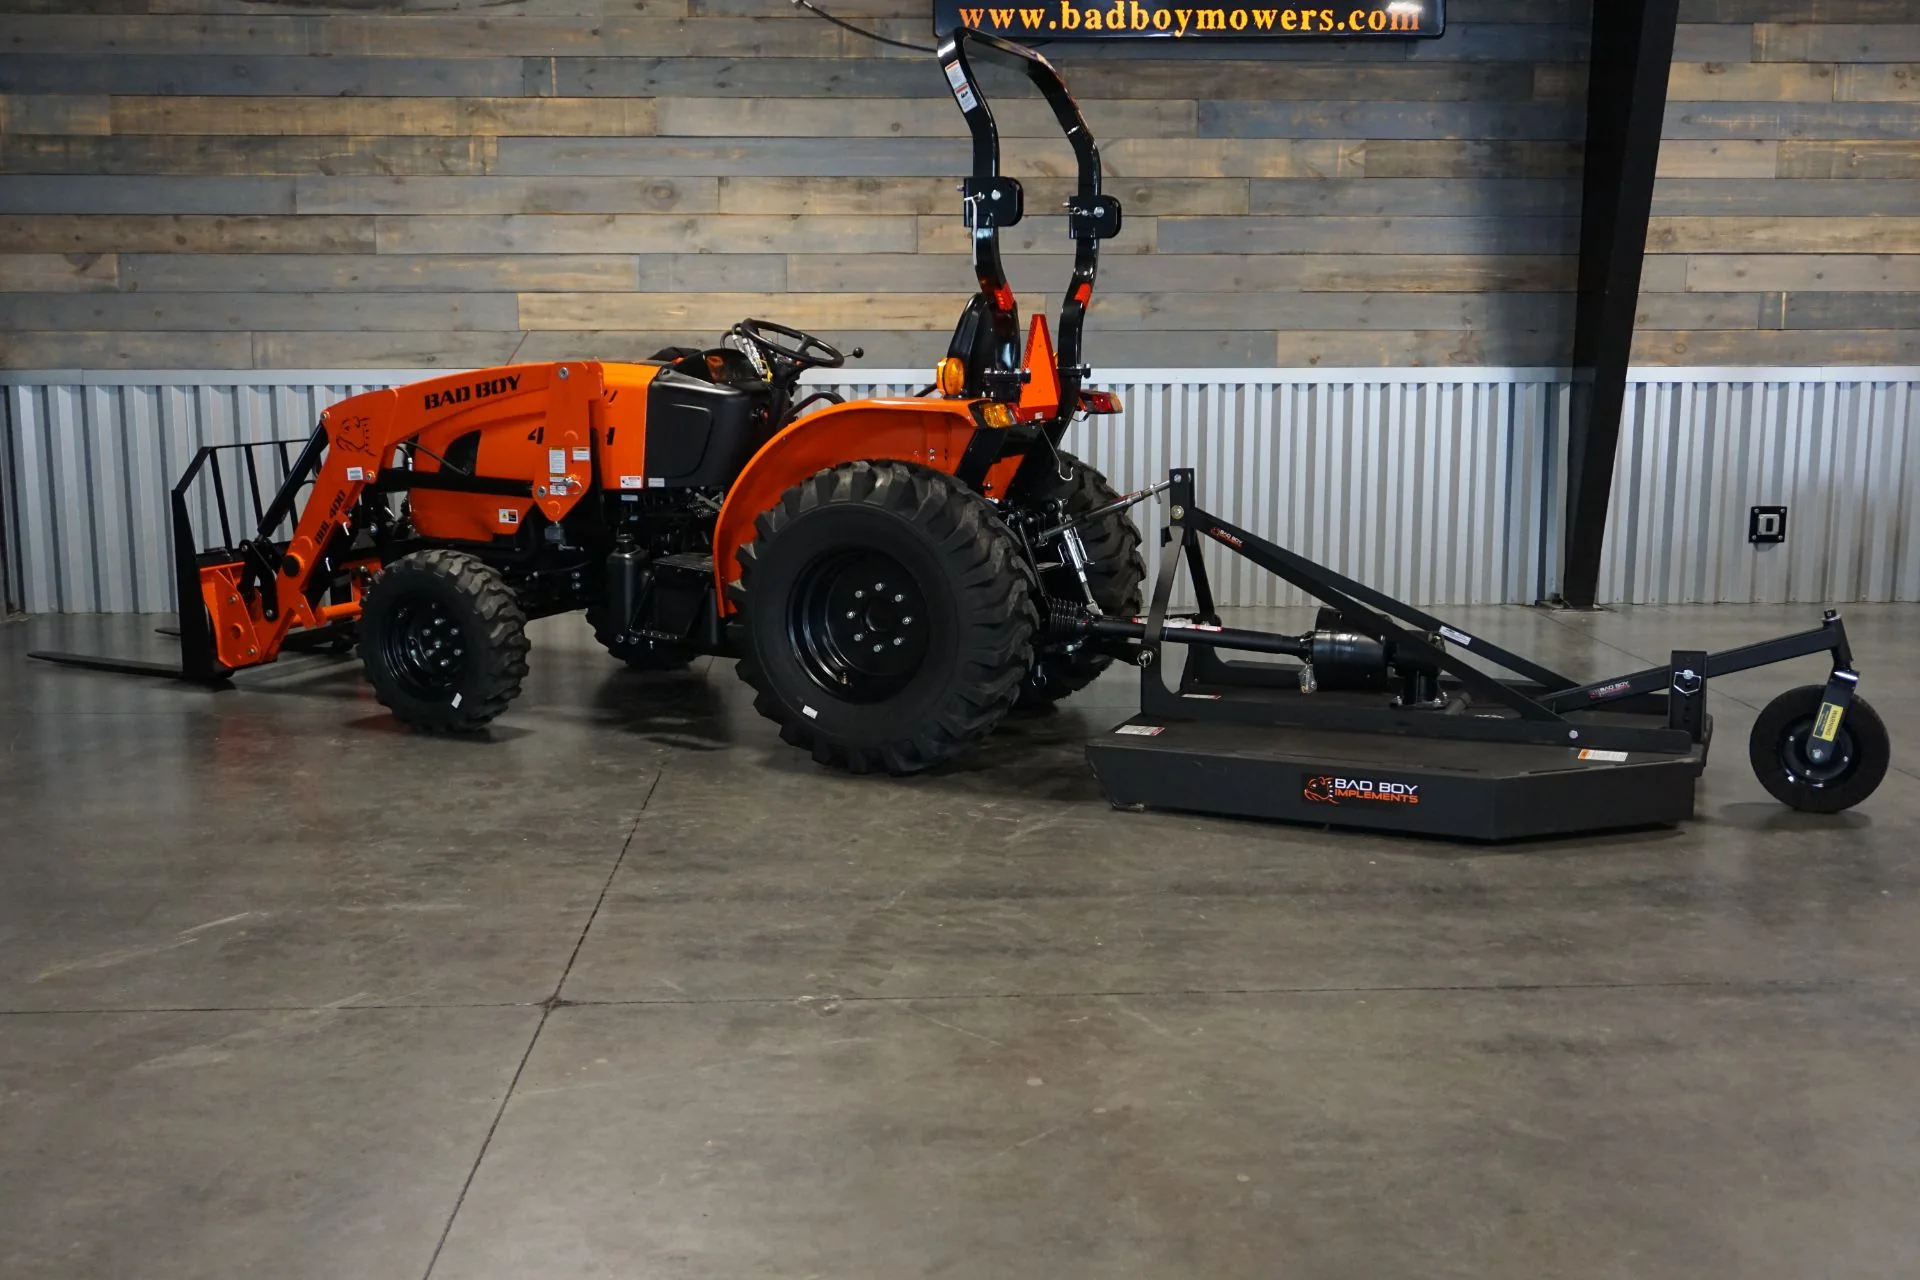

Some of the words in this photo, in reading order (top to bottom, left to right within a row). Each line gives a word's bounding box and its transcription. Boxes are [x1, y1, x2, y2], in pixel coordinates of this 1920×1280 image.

[959, 1, 1419, 37] www.badboymowers.com
[424, 386, 471, 410] BAD
[475, 373, 521, 398] BOY
[1334, 778, 1373, 791] BAD
[1379, 782, 1419, 795] BOY
[1334, 788, 1419, 804] IMPLEMENTS
